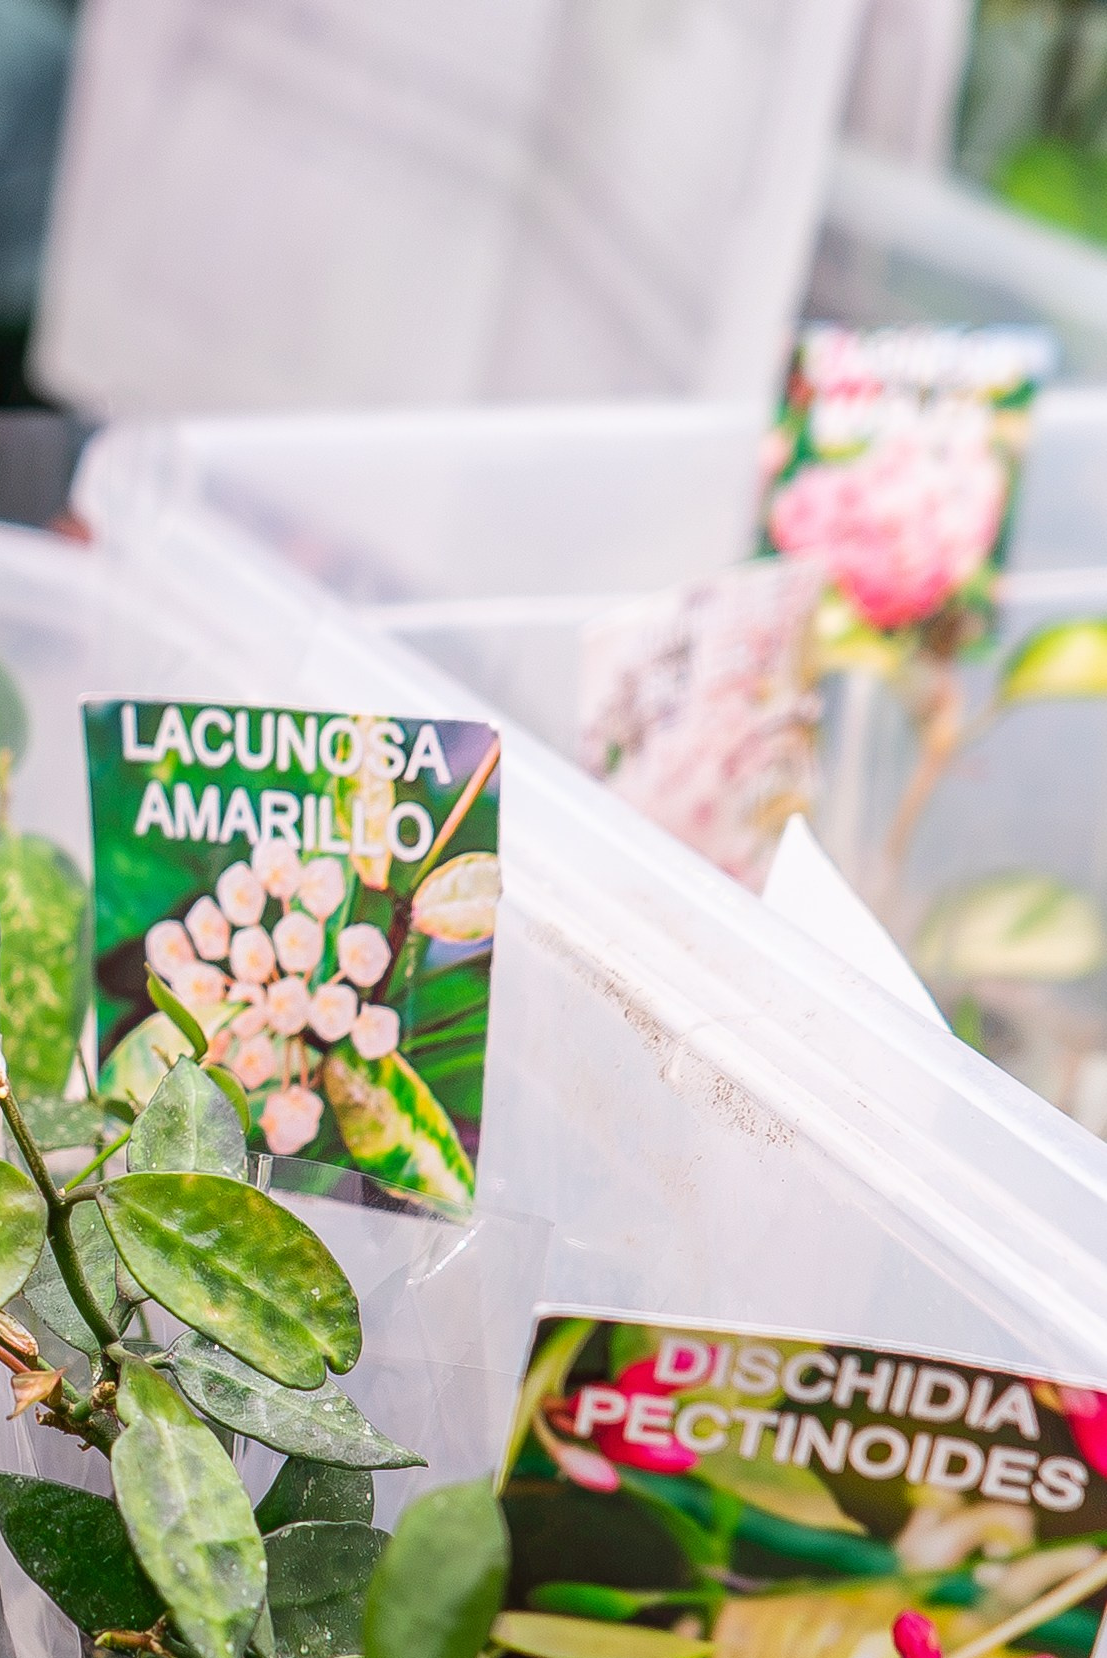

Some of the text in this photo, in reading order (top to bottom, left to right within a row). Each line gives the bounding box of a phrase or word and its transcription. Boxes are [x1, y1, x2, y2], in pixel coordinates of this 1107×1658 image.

[120, 702, 452, 785] LACUNOSA
[134, 780, 435, 862] AMARILLO
[653, 1336, 1041, 1441] DISCHIDIA
[573, 1386, 1090, 1512] PECTINOIDES
